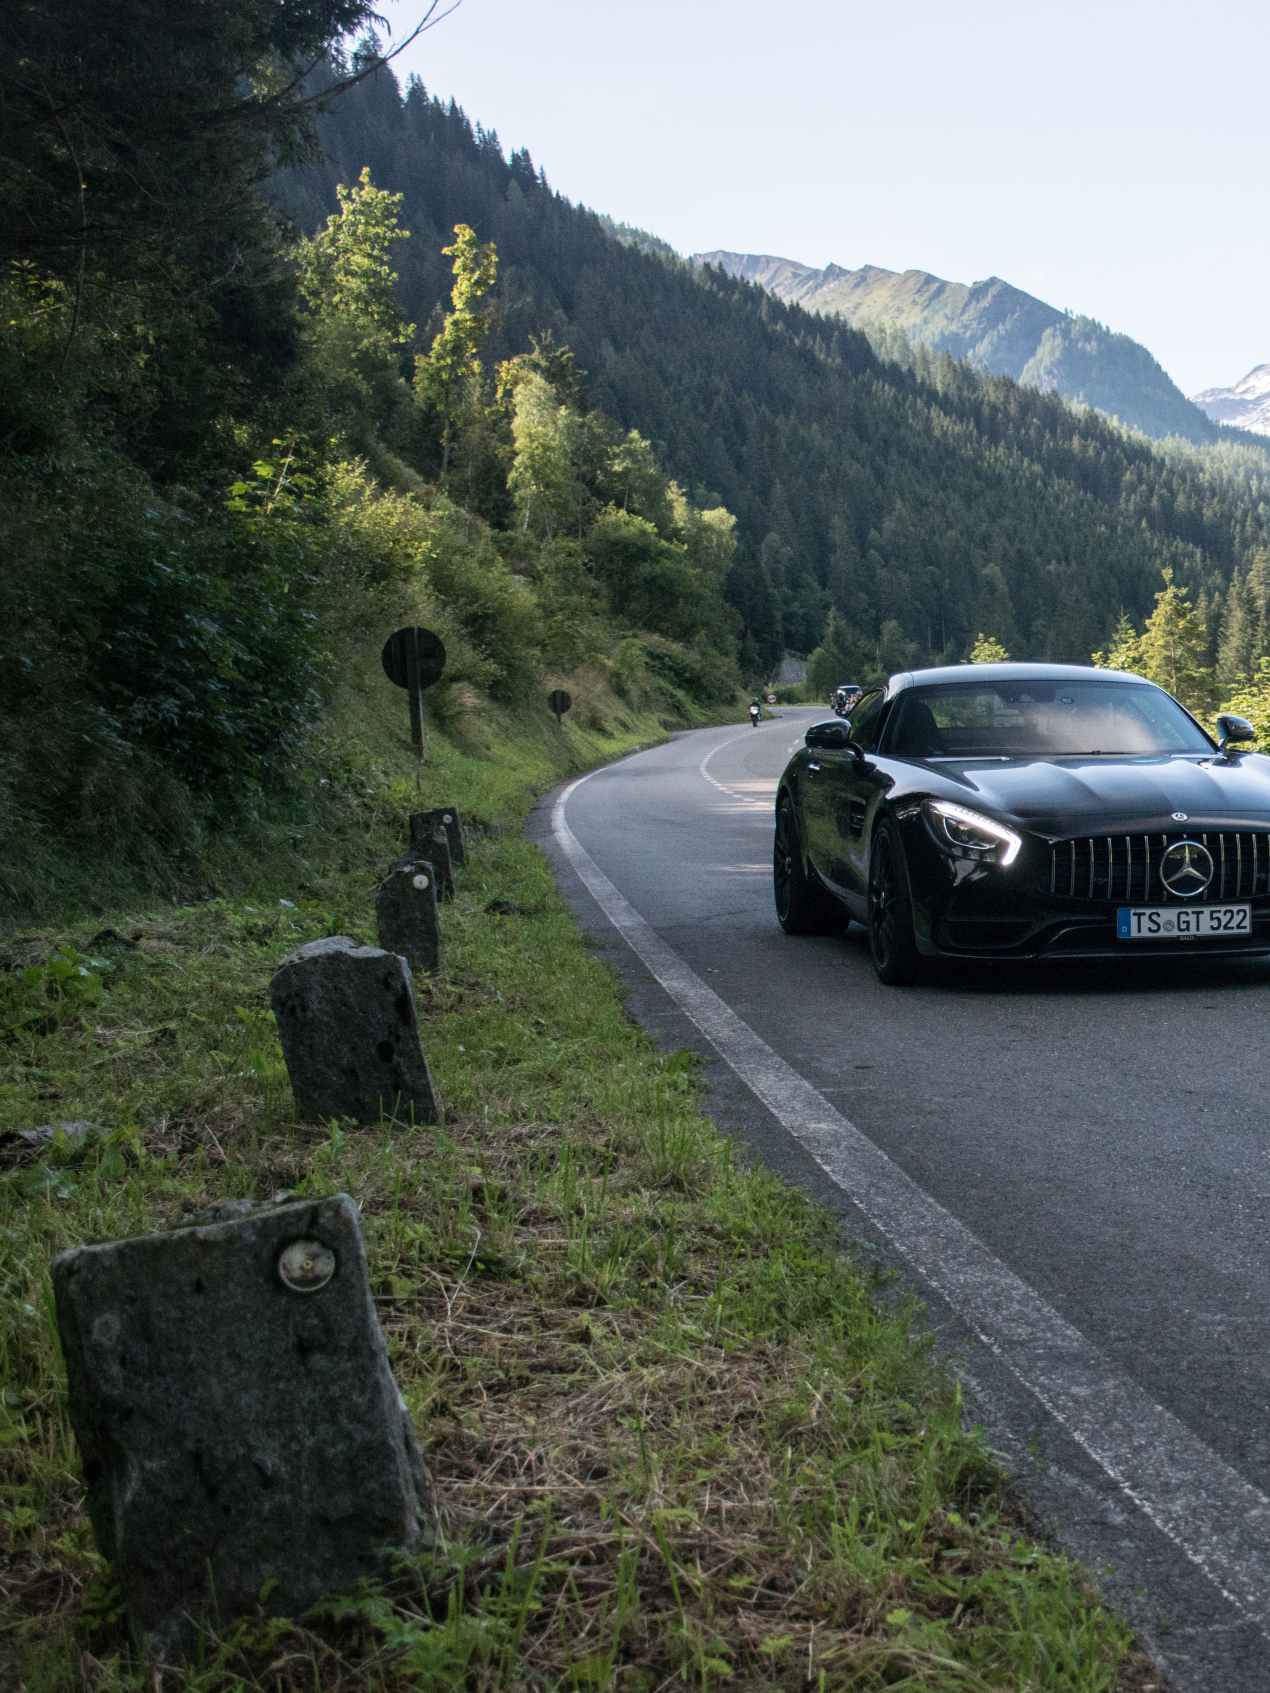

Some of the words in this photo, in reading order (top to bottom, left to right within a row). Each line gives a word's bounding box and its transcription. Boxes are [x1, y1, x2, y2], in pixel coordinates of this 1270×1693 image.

[1132, 911, 1162, 934] TS
[1176, 910, 1205, 933] GT
[1209, 908, 1248, 931] 522
